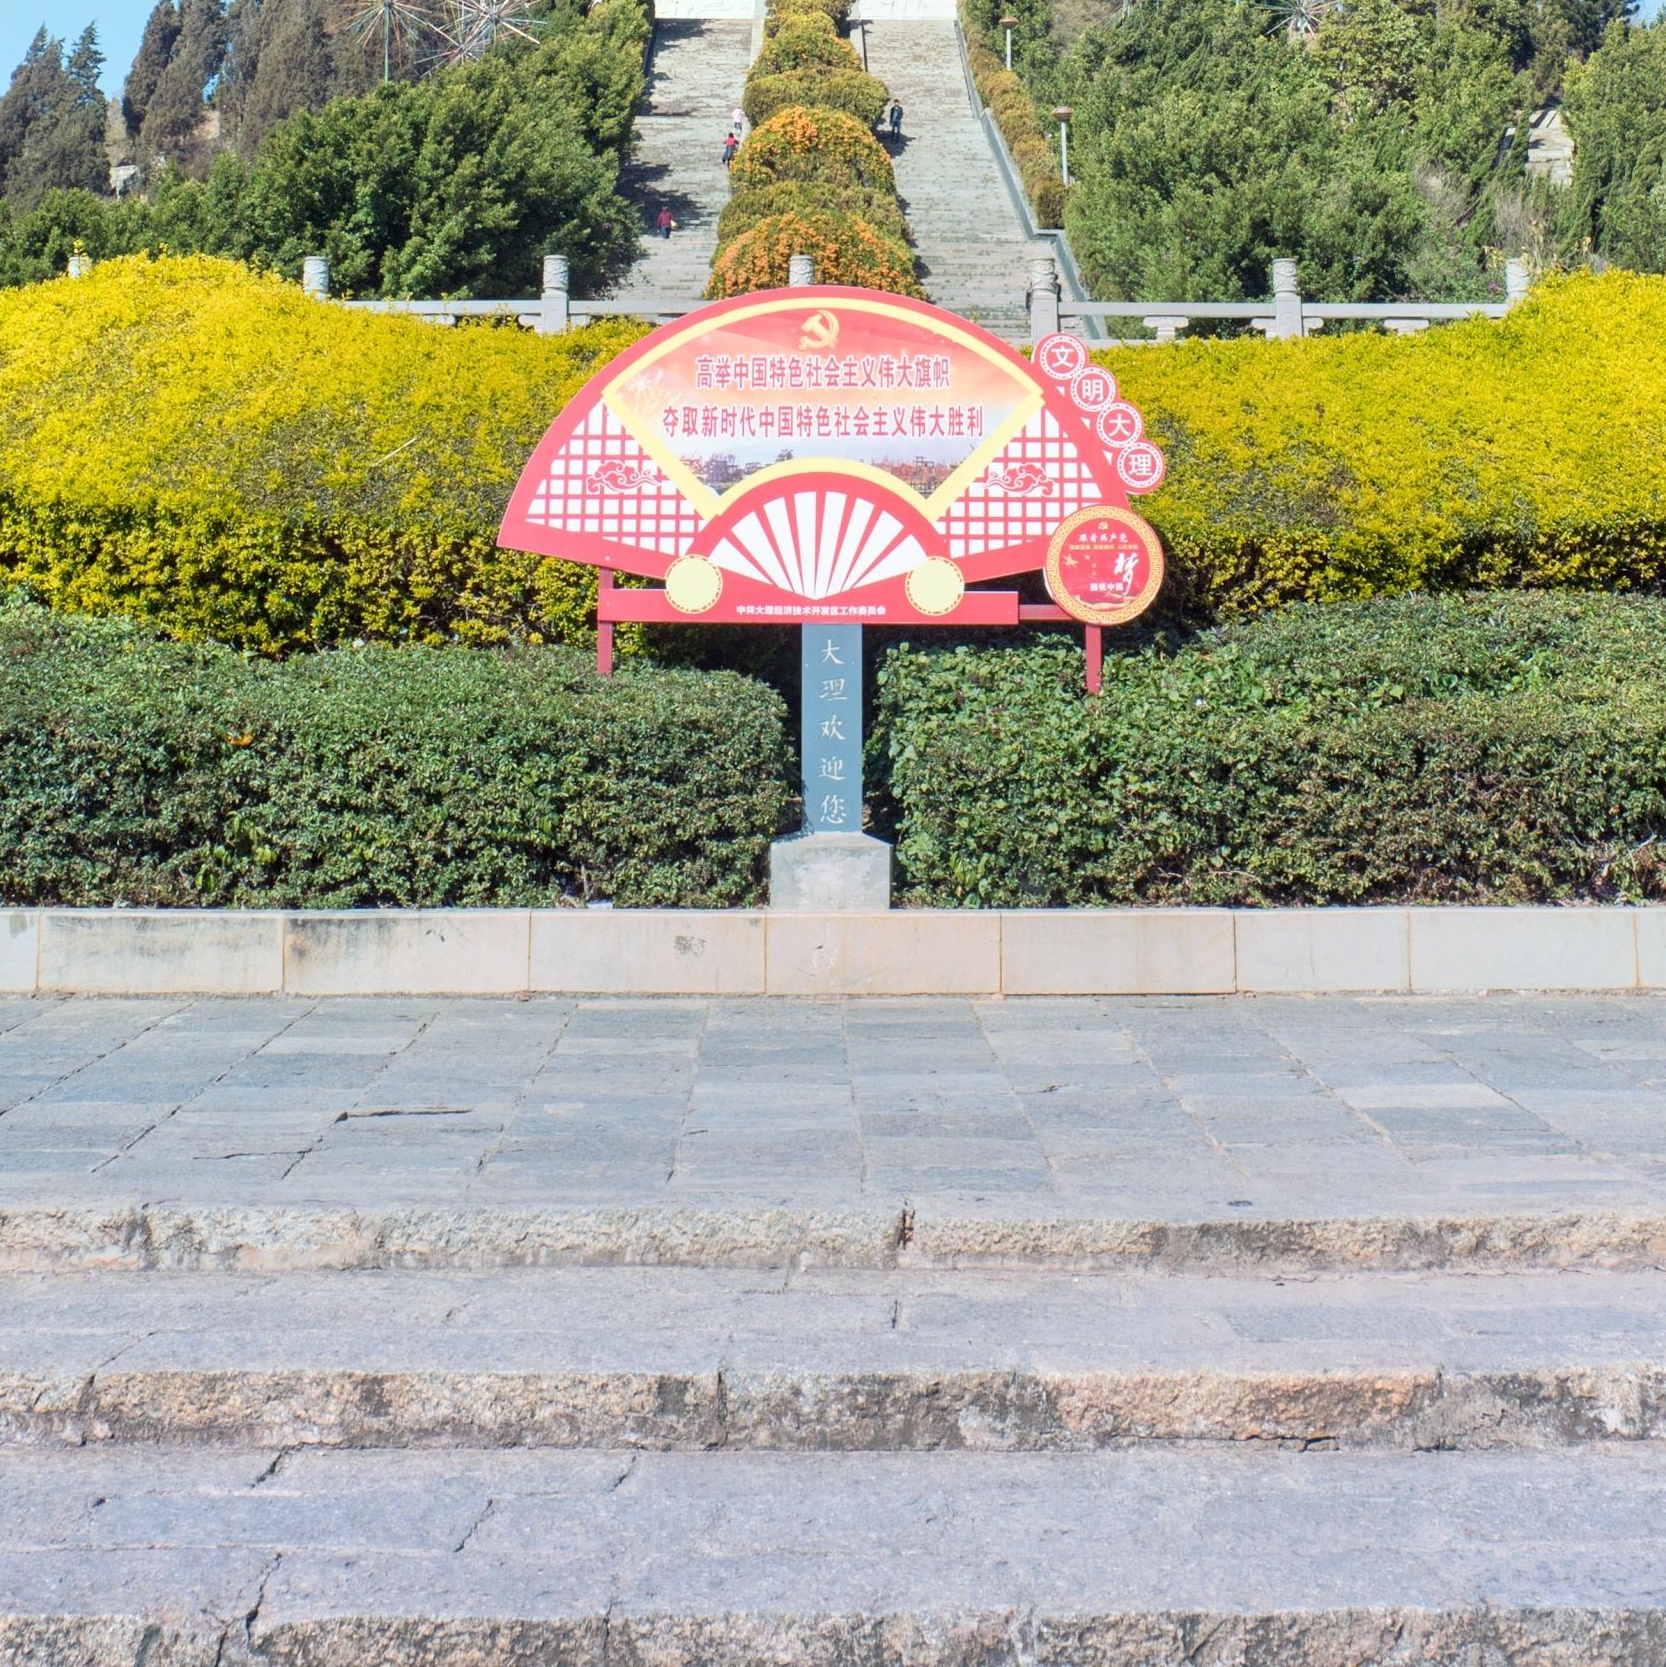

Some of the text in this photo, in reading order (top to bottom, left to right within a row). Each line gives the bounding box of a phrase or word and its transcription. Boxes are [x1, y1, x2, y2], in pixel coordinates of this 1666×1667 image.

[696, 356, 950, 389] 高举中国特色社会主义伟大旗帜
[1051, 345, 1152, 476] 文明大理
[662, 405, 983, 438] 夺取新时代中国特色社会主义伟大胜利
[819, 639, 847, 825] 大理欢迎您
